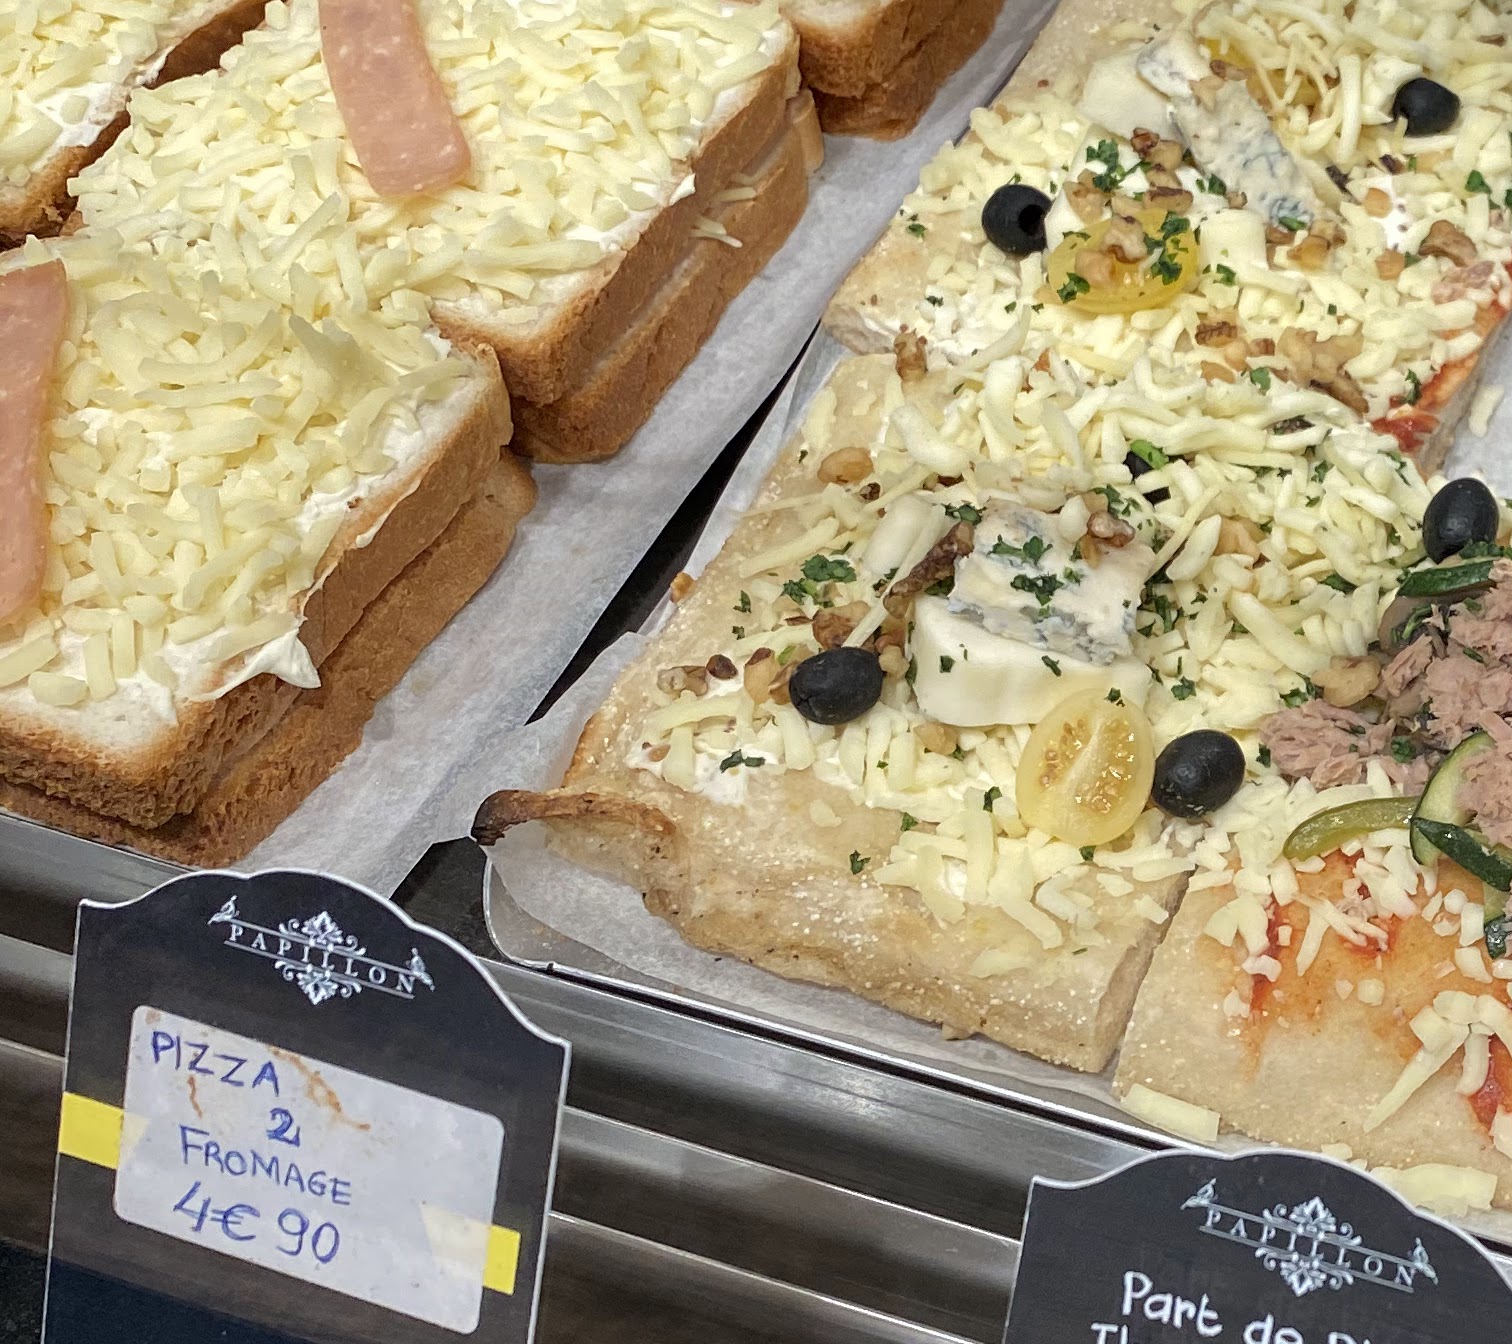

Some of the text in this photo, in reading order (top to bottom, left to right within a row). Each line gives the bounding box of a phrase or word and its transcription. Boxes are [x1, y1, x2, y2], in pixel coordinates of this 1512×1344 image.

[229, 922, 416, 994] PAPILLON
[150, 1030, 280, 1097] PIZZA
[267, 1108, 301, 1147] 2
[179, 1124, 352, 1206] FROMAGE
[1205, 1209, 1417, 1285] PAPILLON
[1121, 1270, 1223, 1337] Part
